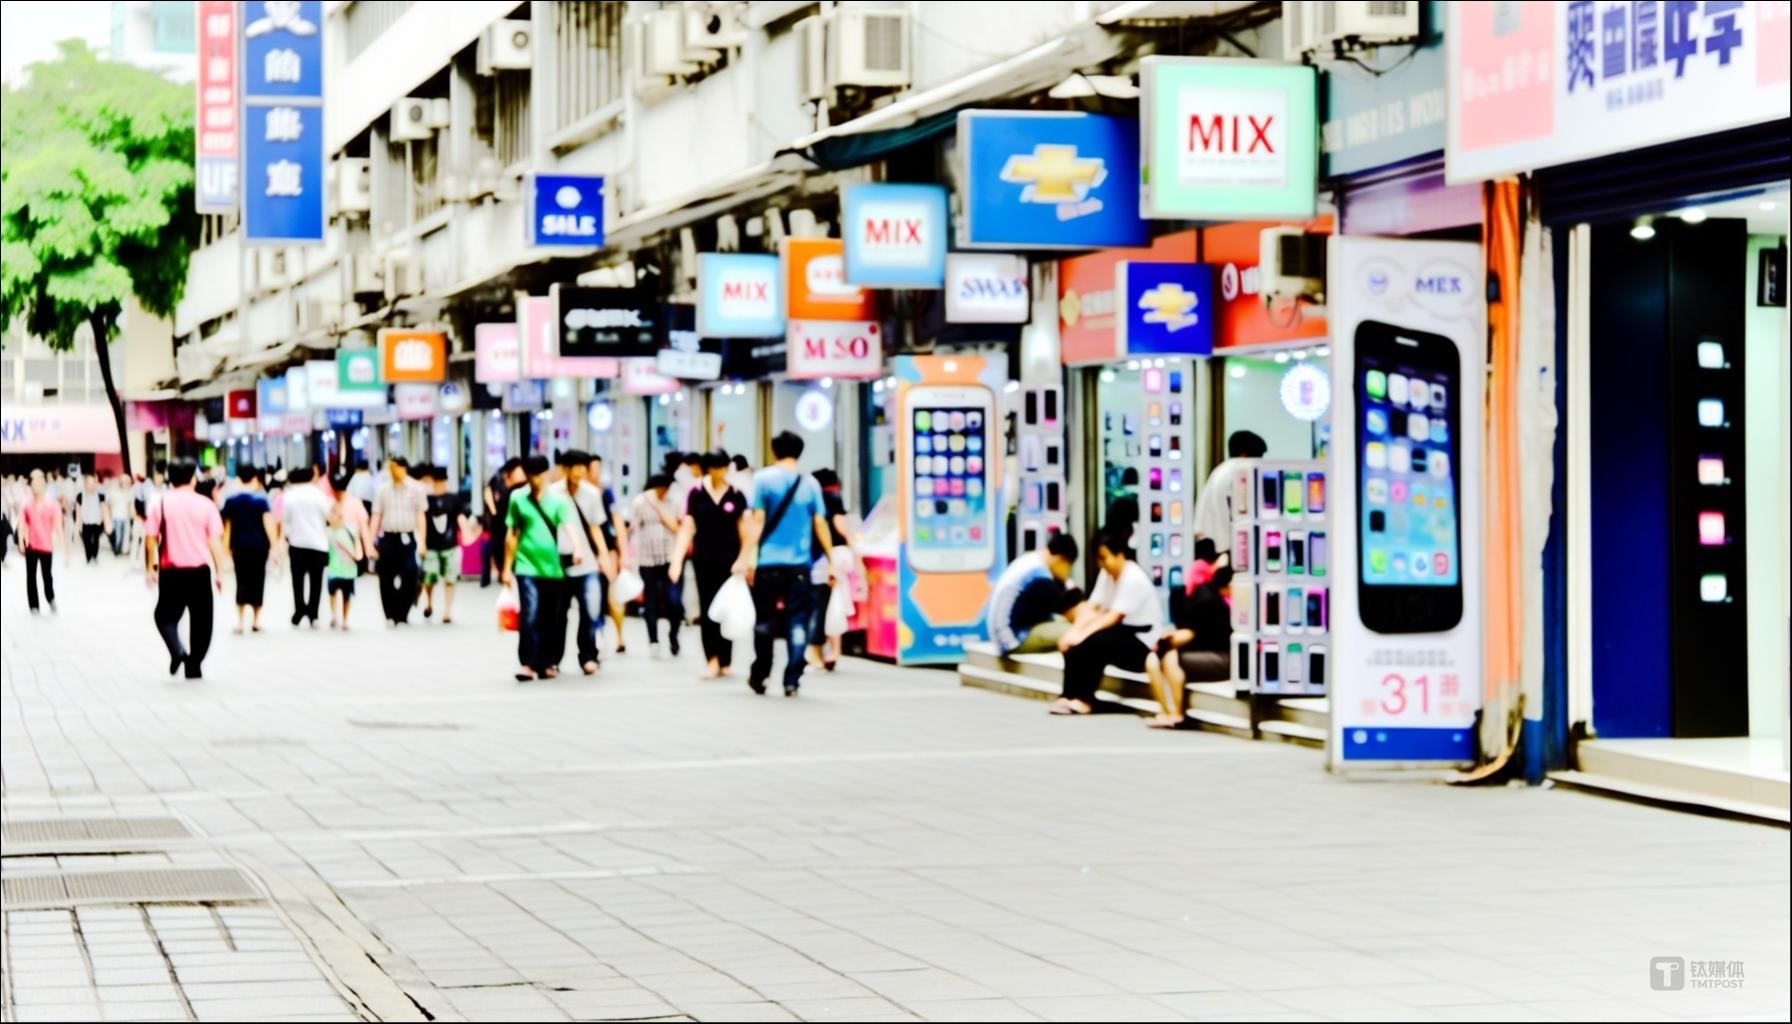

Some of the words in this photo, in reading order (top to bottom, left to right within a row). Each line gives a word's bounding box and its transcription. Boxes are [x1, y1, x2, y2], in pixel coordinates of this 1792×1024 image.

[1188, 113, 1275, 153] MIX
[865, 218, 922, 245] MIX
[723, 281, 767, 300] MIX
[1380, 673, 1429, 715] 31
